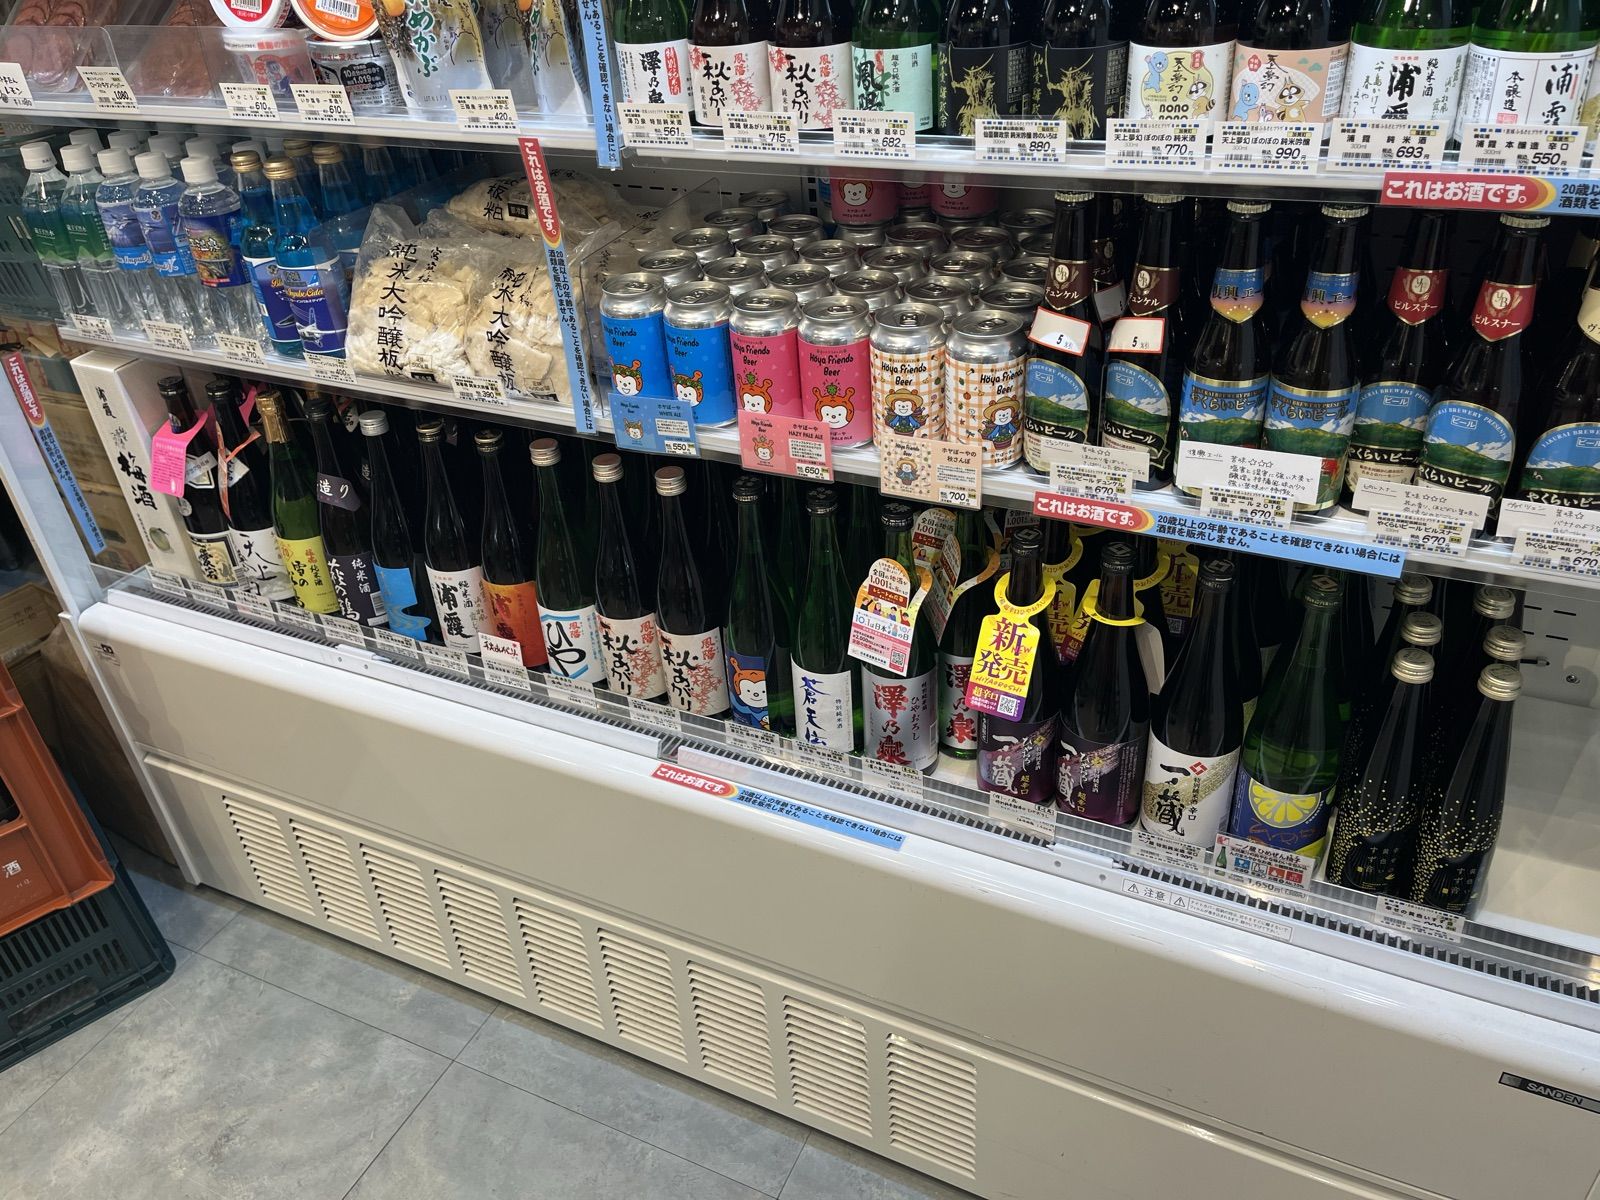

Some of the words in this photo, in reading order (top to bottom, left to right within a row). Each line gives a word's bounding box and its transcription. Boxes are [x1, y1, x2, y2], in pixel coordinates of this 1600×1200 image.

[663, 126, 681, 137] 561
[768, 132, 787, 144] 715
[881, 136, 901, 148] 682
[1028, 141, 1051, 152] 880
[1164, 144, 1188, 156] 770
[1274, 147, 1301, 160] 990
[1395, 146, 1424, 158] 693
[1531, 152, 1562, 165] 550
[523, 140, 558, 237] これはお酒です。
[1384, 180, 1528, 205] これはお酒です。
[376, 242, 419, 377] 純米大吟醸板
[1474, 314, 1521, 330] ピルスナー
[827, 352, 854, 364] Friends
[823, 365, 841, 378] Beer
[899, 363, 927, 375] Friends
[1002, 367, 1024, 384] Friends
[894, 375, 914, 387] Beer
[996, 383, 1014, 396] Beer
[1384, 396, 1409, 406] ビール
[1448, 406, 1483, 419] BREWERY
[1452, 416, 1477, 429] ビール
[672, 443, 687, 451] 550
[804, 466, 820, 475] 650
[948, 491, 966, 501] 700
[1094, 485, 1114, 496] 670
[1035, 496, 1137, 528] これはお酒です。
[1249, 508, 1272, 519] 670
[1155, 524, 1252, 549] 酒類を販売しません。
[1157, 513, 1402, 565] 20歳以上の年齢であることを確認できない場合には
[1421, 534, 1447, 546] 670
[1572, 556, 1600, 568] 670
[599, 620, 639, 697] 秋あがり
[660, 634, 699, 712] 秋あがり
[654, 766, 726, 795] これはお酒です。
[1143, 886, 1166, 902] 注意
[1526, 1082, 1585, 1106] SANDEN
